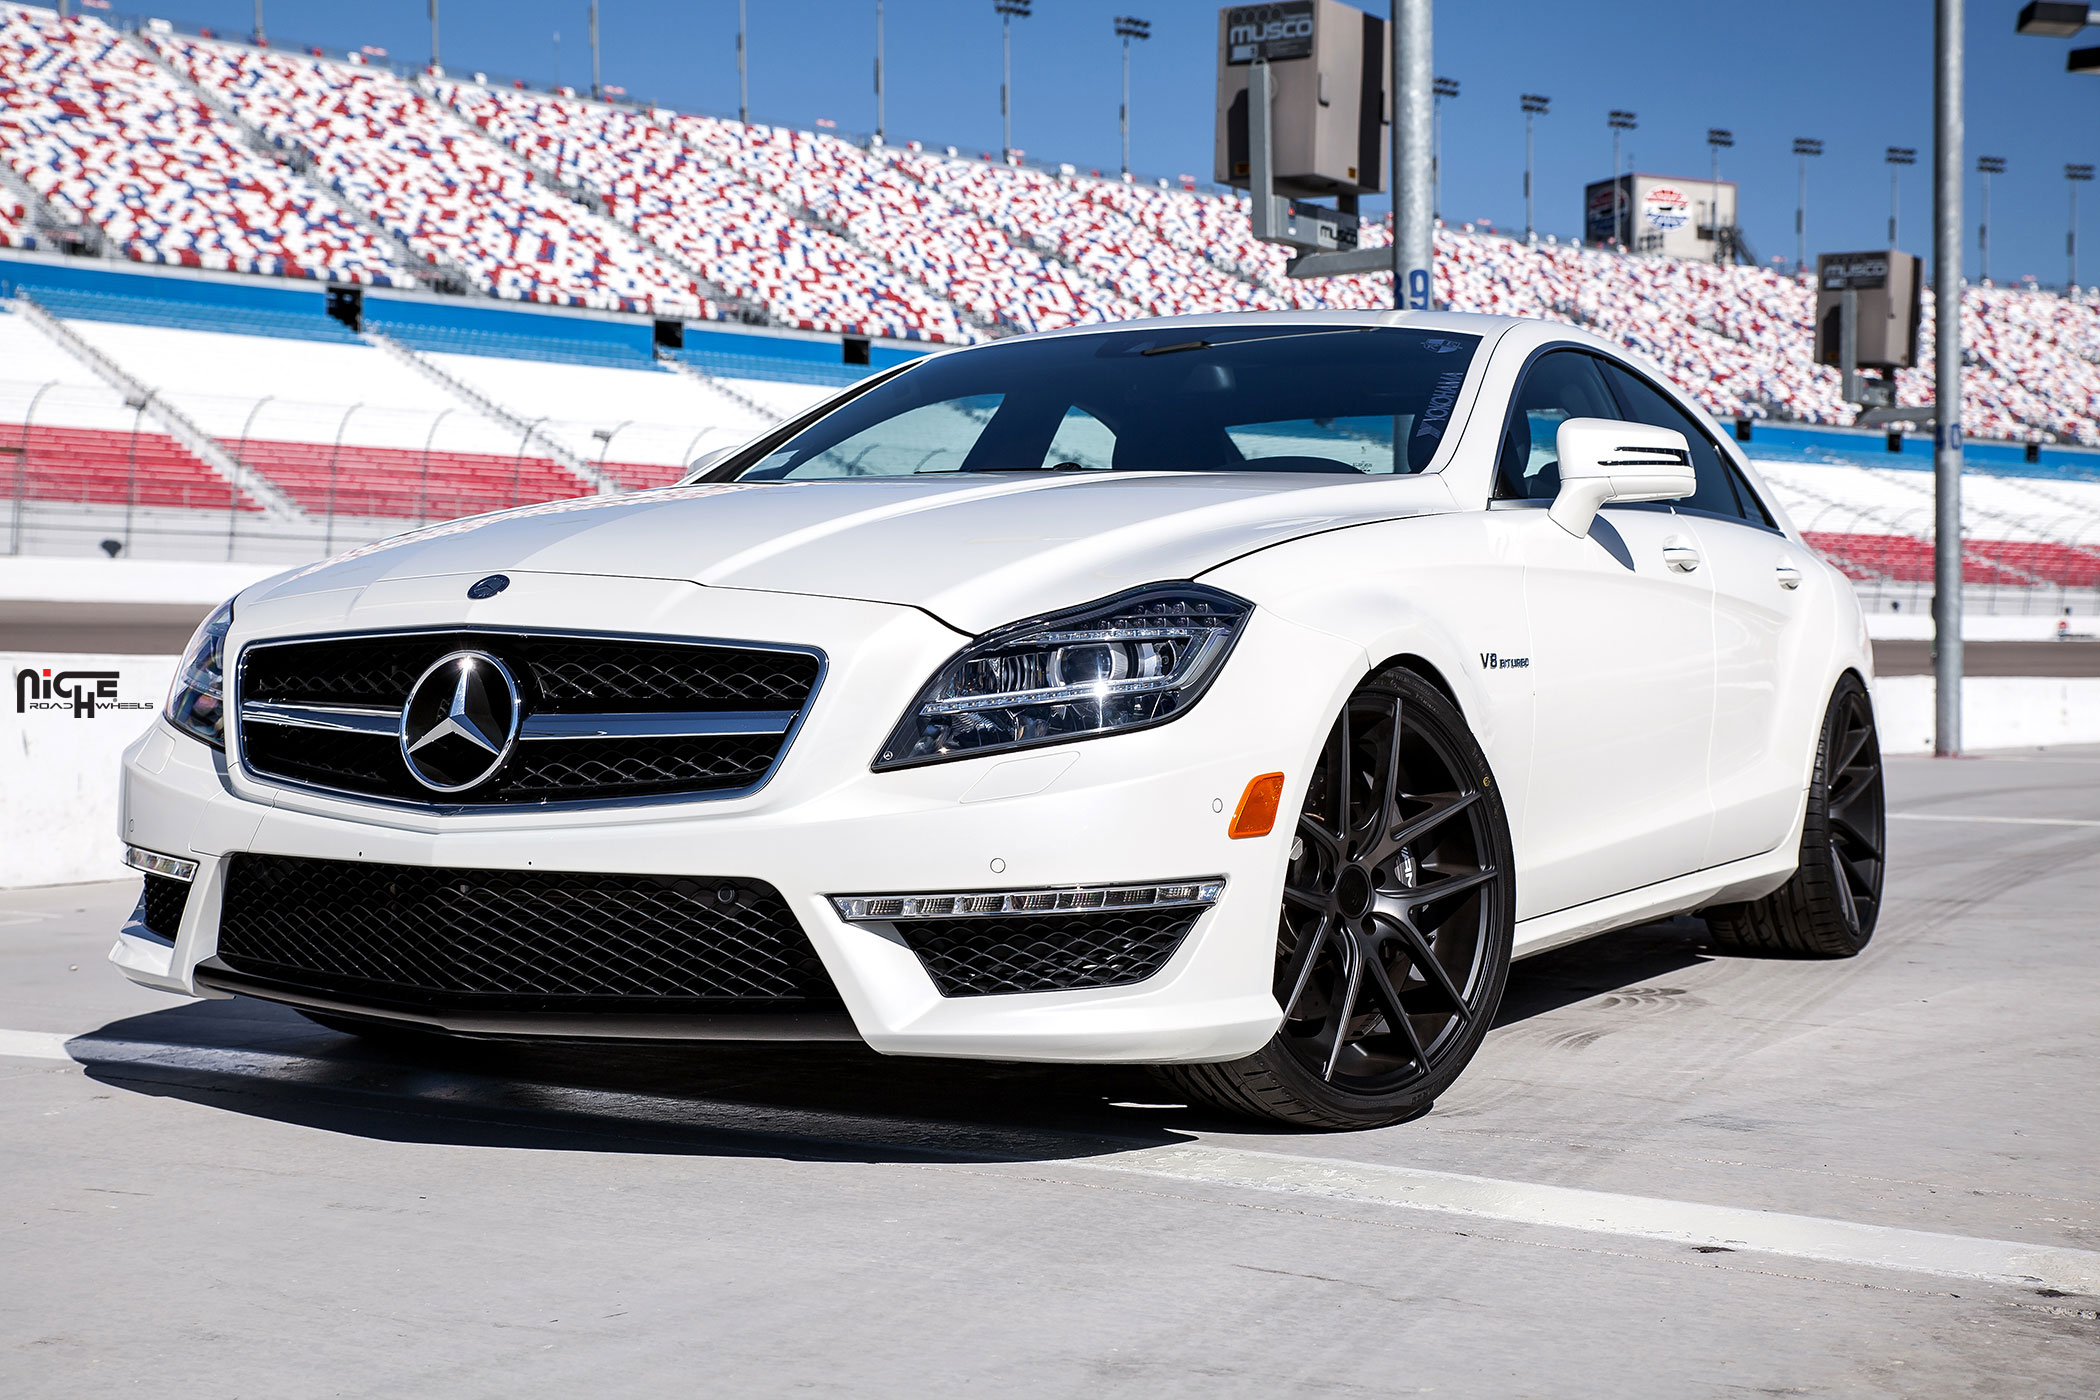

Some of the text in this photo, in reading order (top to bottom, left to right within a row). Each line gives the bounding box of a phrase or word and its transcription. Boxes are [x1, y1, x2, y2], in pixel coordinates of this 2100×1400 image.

[1423, 372, 1463, 421] YOKOHAMA
[1480, 652, 1529, 669] V8 BITURBO
